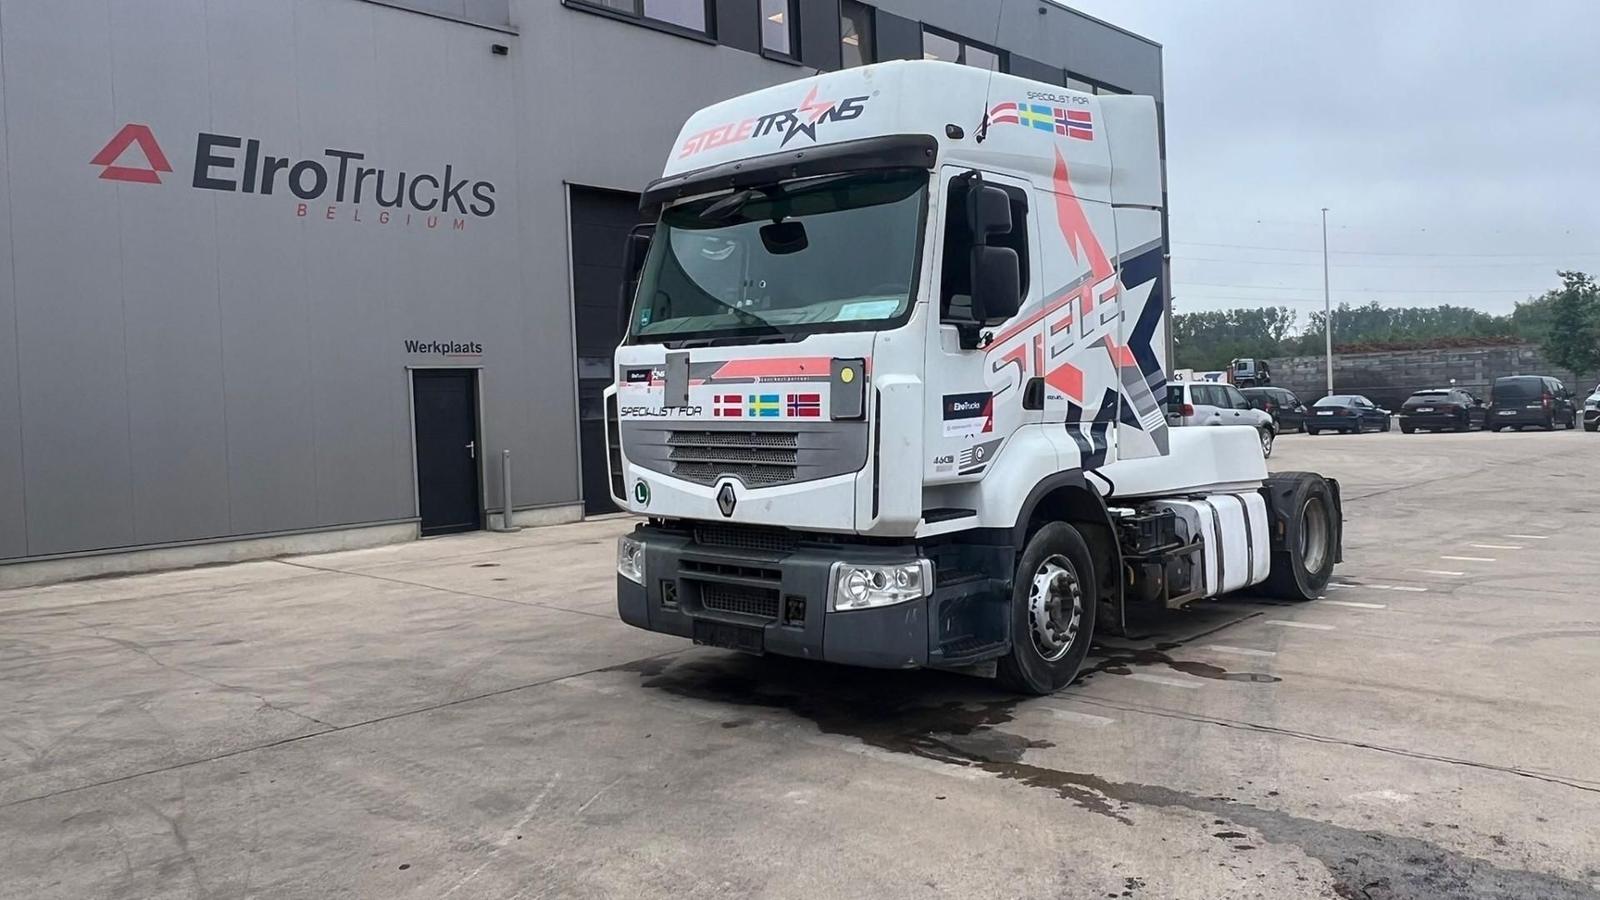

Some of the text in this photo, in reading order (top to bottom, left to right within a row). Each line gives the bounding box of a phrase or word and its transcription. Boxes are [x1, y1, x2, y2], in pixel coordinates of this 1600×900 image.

[192, 132, 496, 218] ElroTrucks
[296, 203, 465, 231] BELGIUM
[404, 339, 483, 356] Werkplaats
[984, 273, 1123, 399] STELE
[620, 406, 703, 417] SPECIALIST FOR
